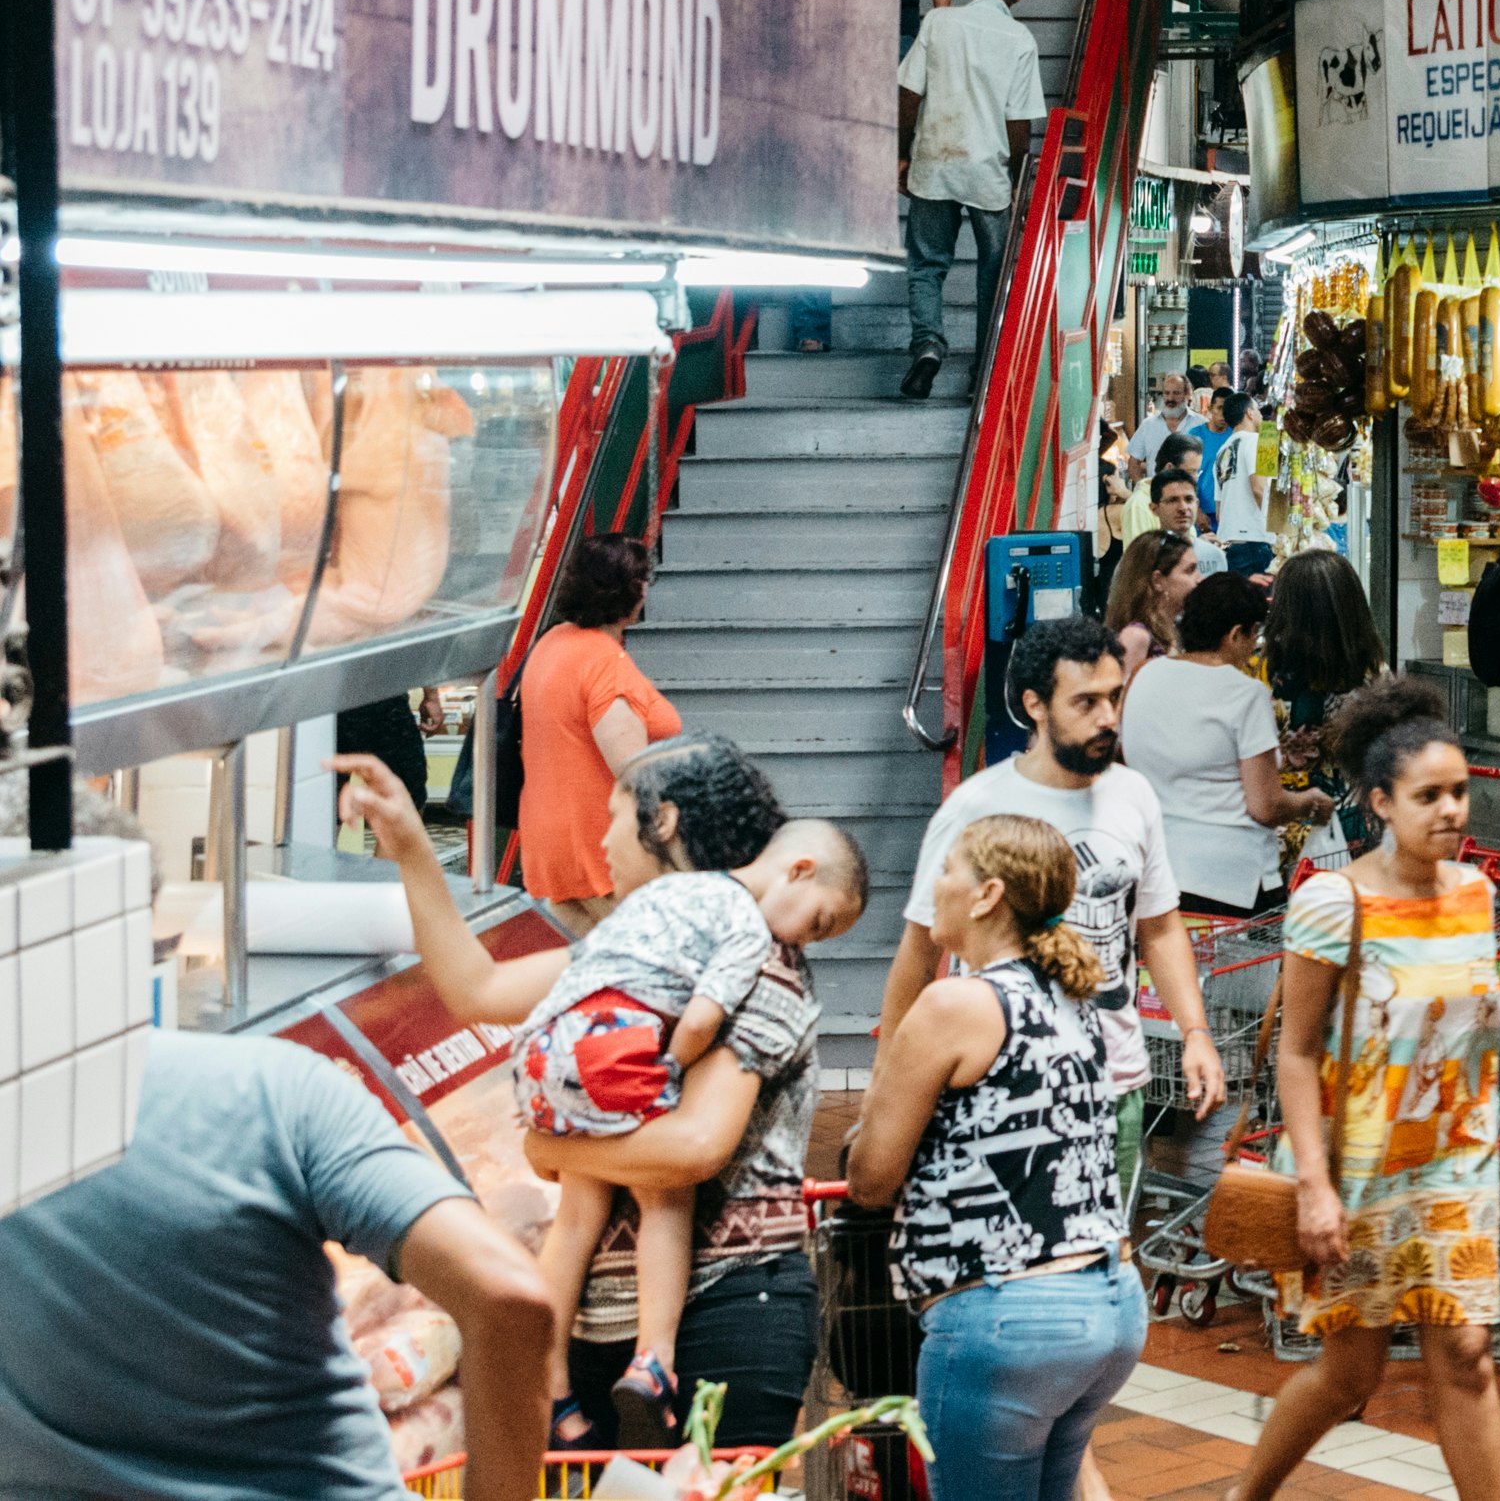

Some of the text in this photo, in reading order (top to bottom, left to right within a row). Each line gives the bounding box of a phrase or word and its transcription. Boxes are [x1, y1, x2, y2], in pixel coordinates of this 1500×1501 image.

[72, 35, 220, 163] LOJA 139
[430, 1028, 487, 1076] DENTRO
